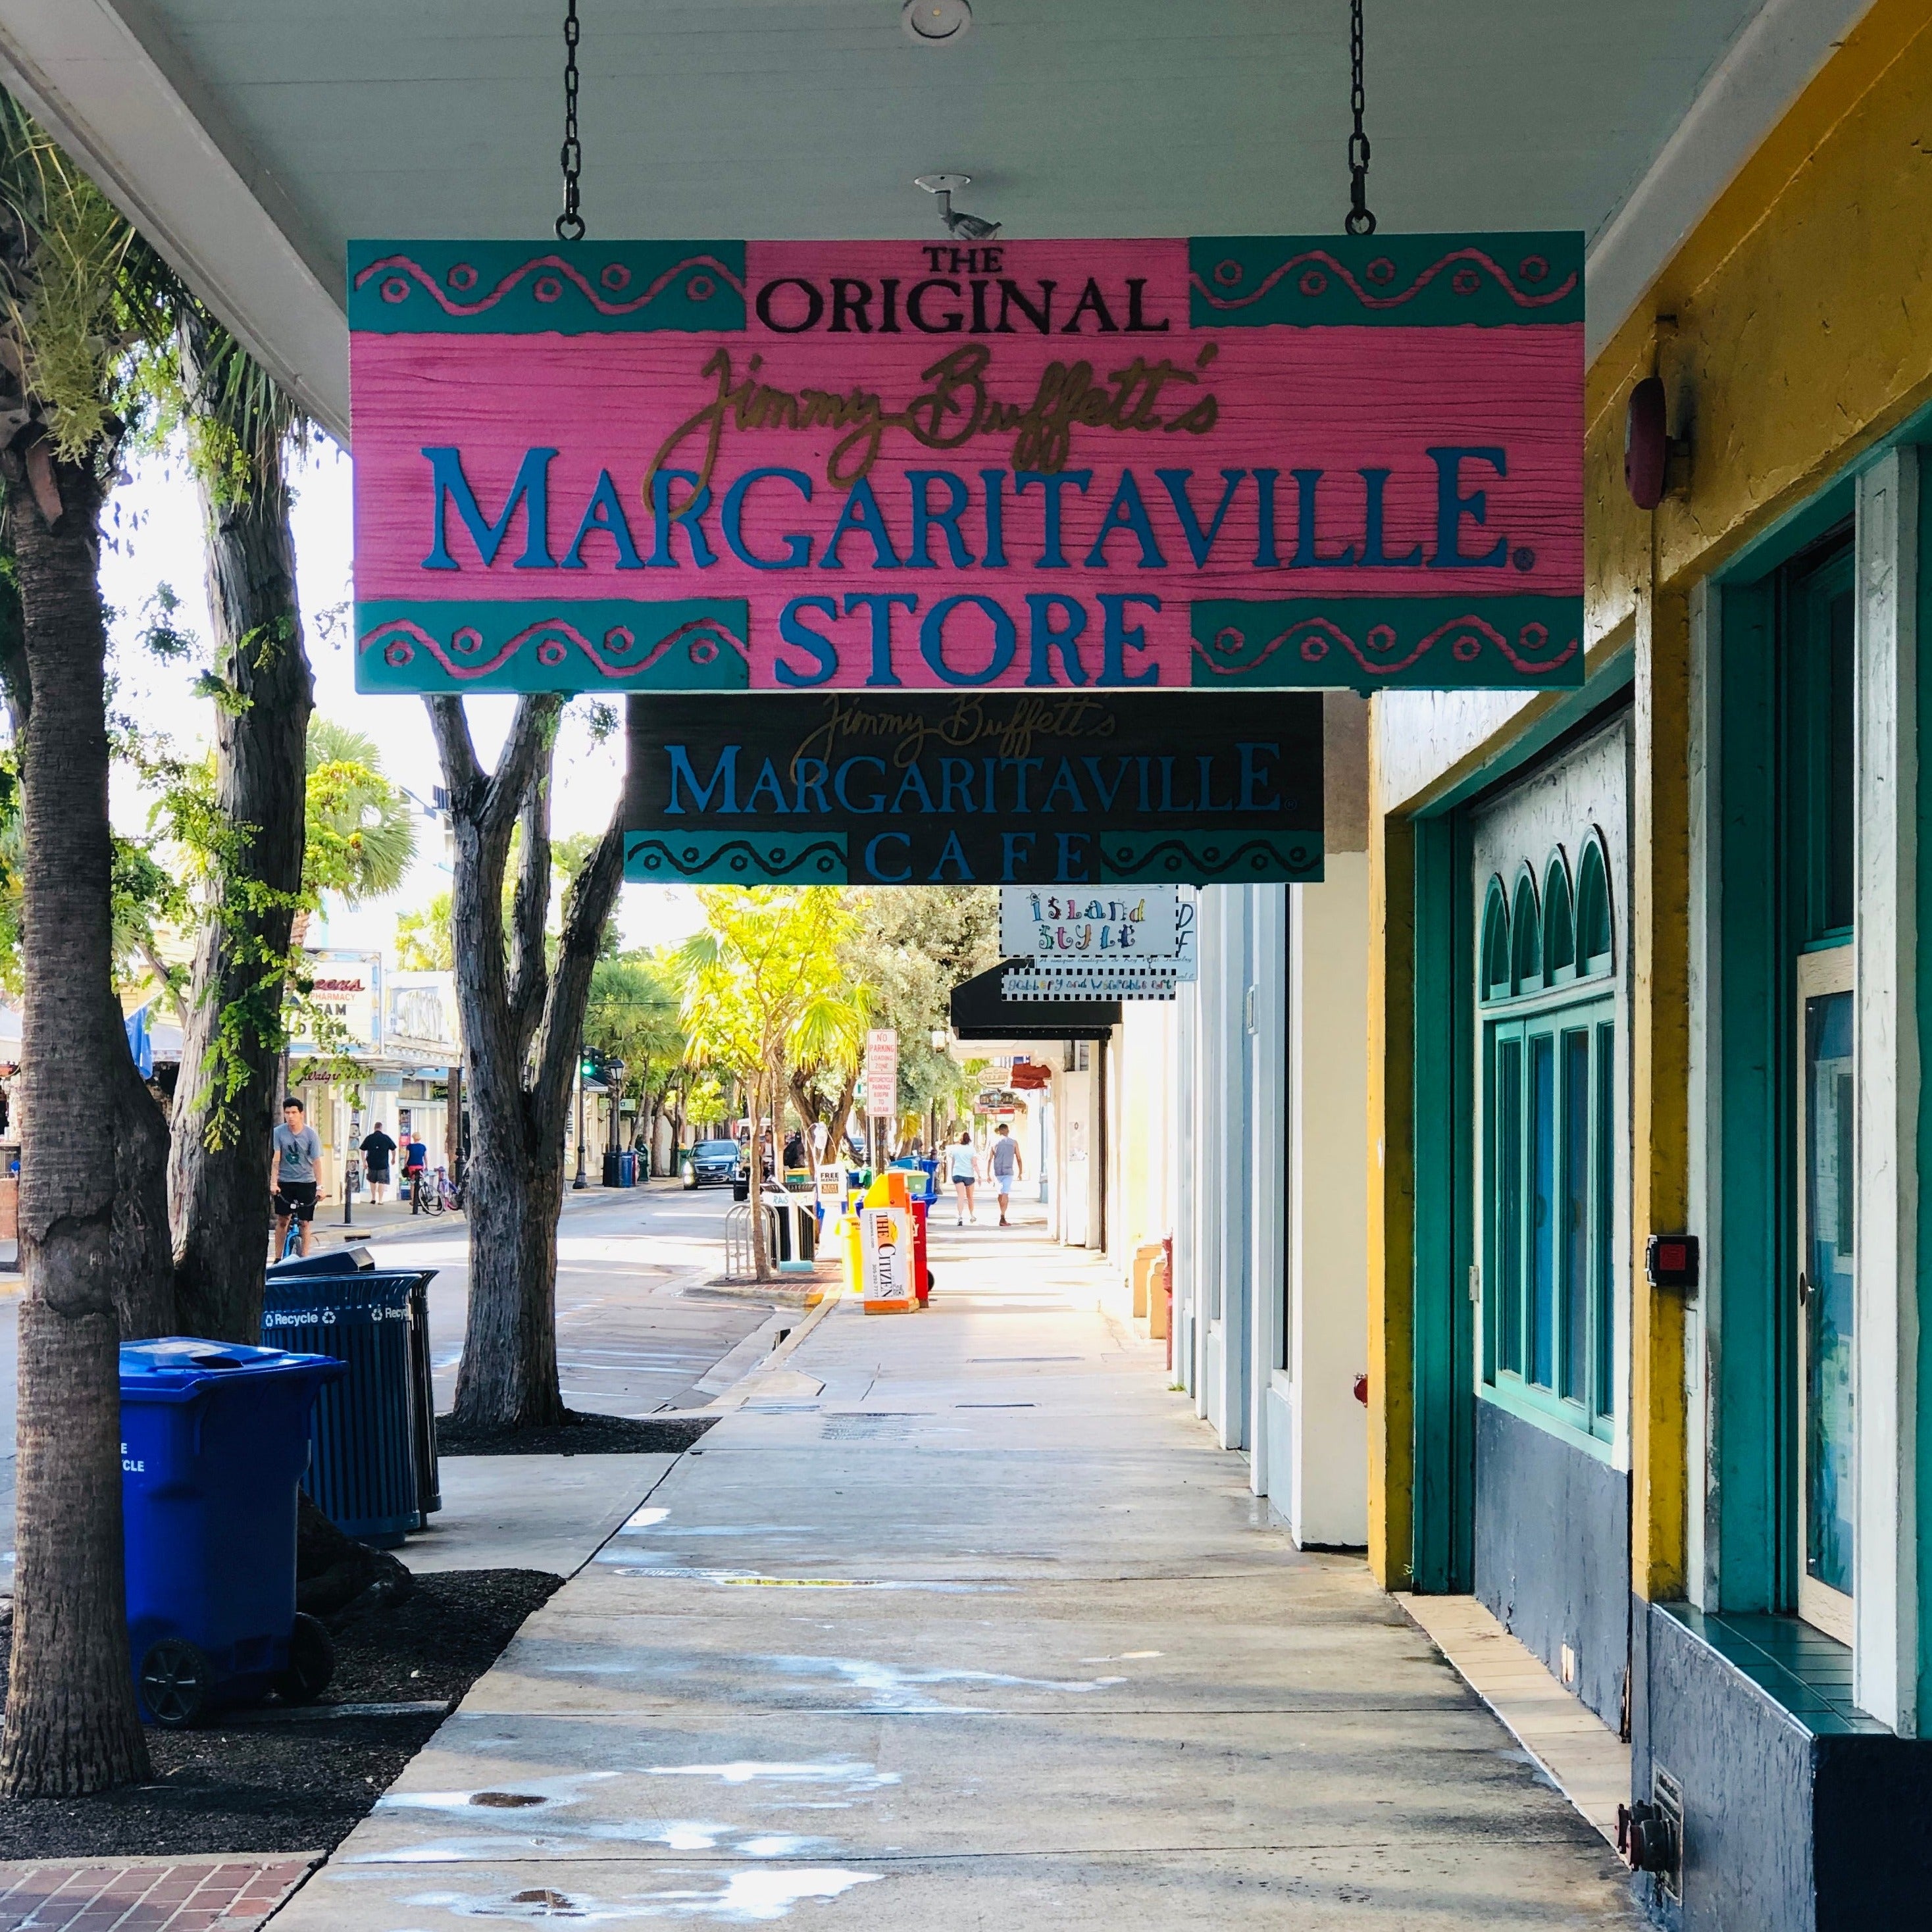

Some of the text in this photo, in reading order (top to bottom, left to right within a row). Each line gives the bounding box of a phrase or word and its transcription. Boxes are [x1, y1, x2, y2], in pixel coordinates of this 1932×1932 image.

[922, 247, 1004, 274] THE
[755, 278, 1169, 336] ORIGINAL
[642, 342, 1219, 520] Jimmy Buffett's
[775, 592, 1163, 688] STORE
[789, 692, 927, 787] Jimmy
[864, 832, 1092, 883] CAFE
[310, 992, 356, 1001] PHARMACY
[877, 1033, 888, 1042] NO
[876, 1212, 896, 1298] THE CITIZEN
[275, 1311, 318, 1327] Recycle
